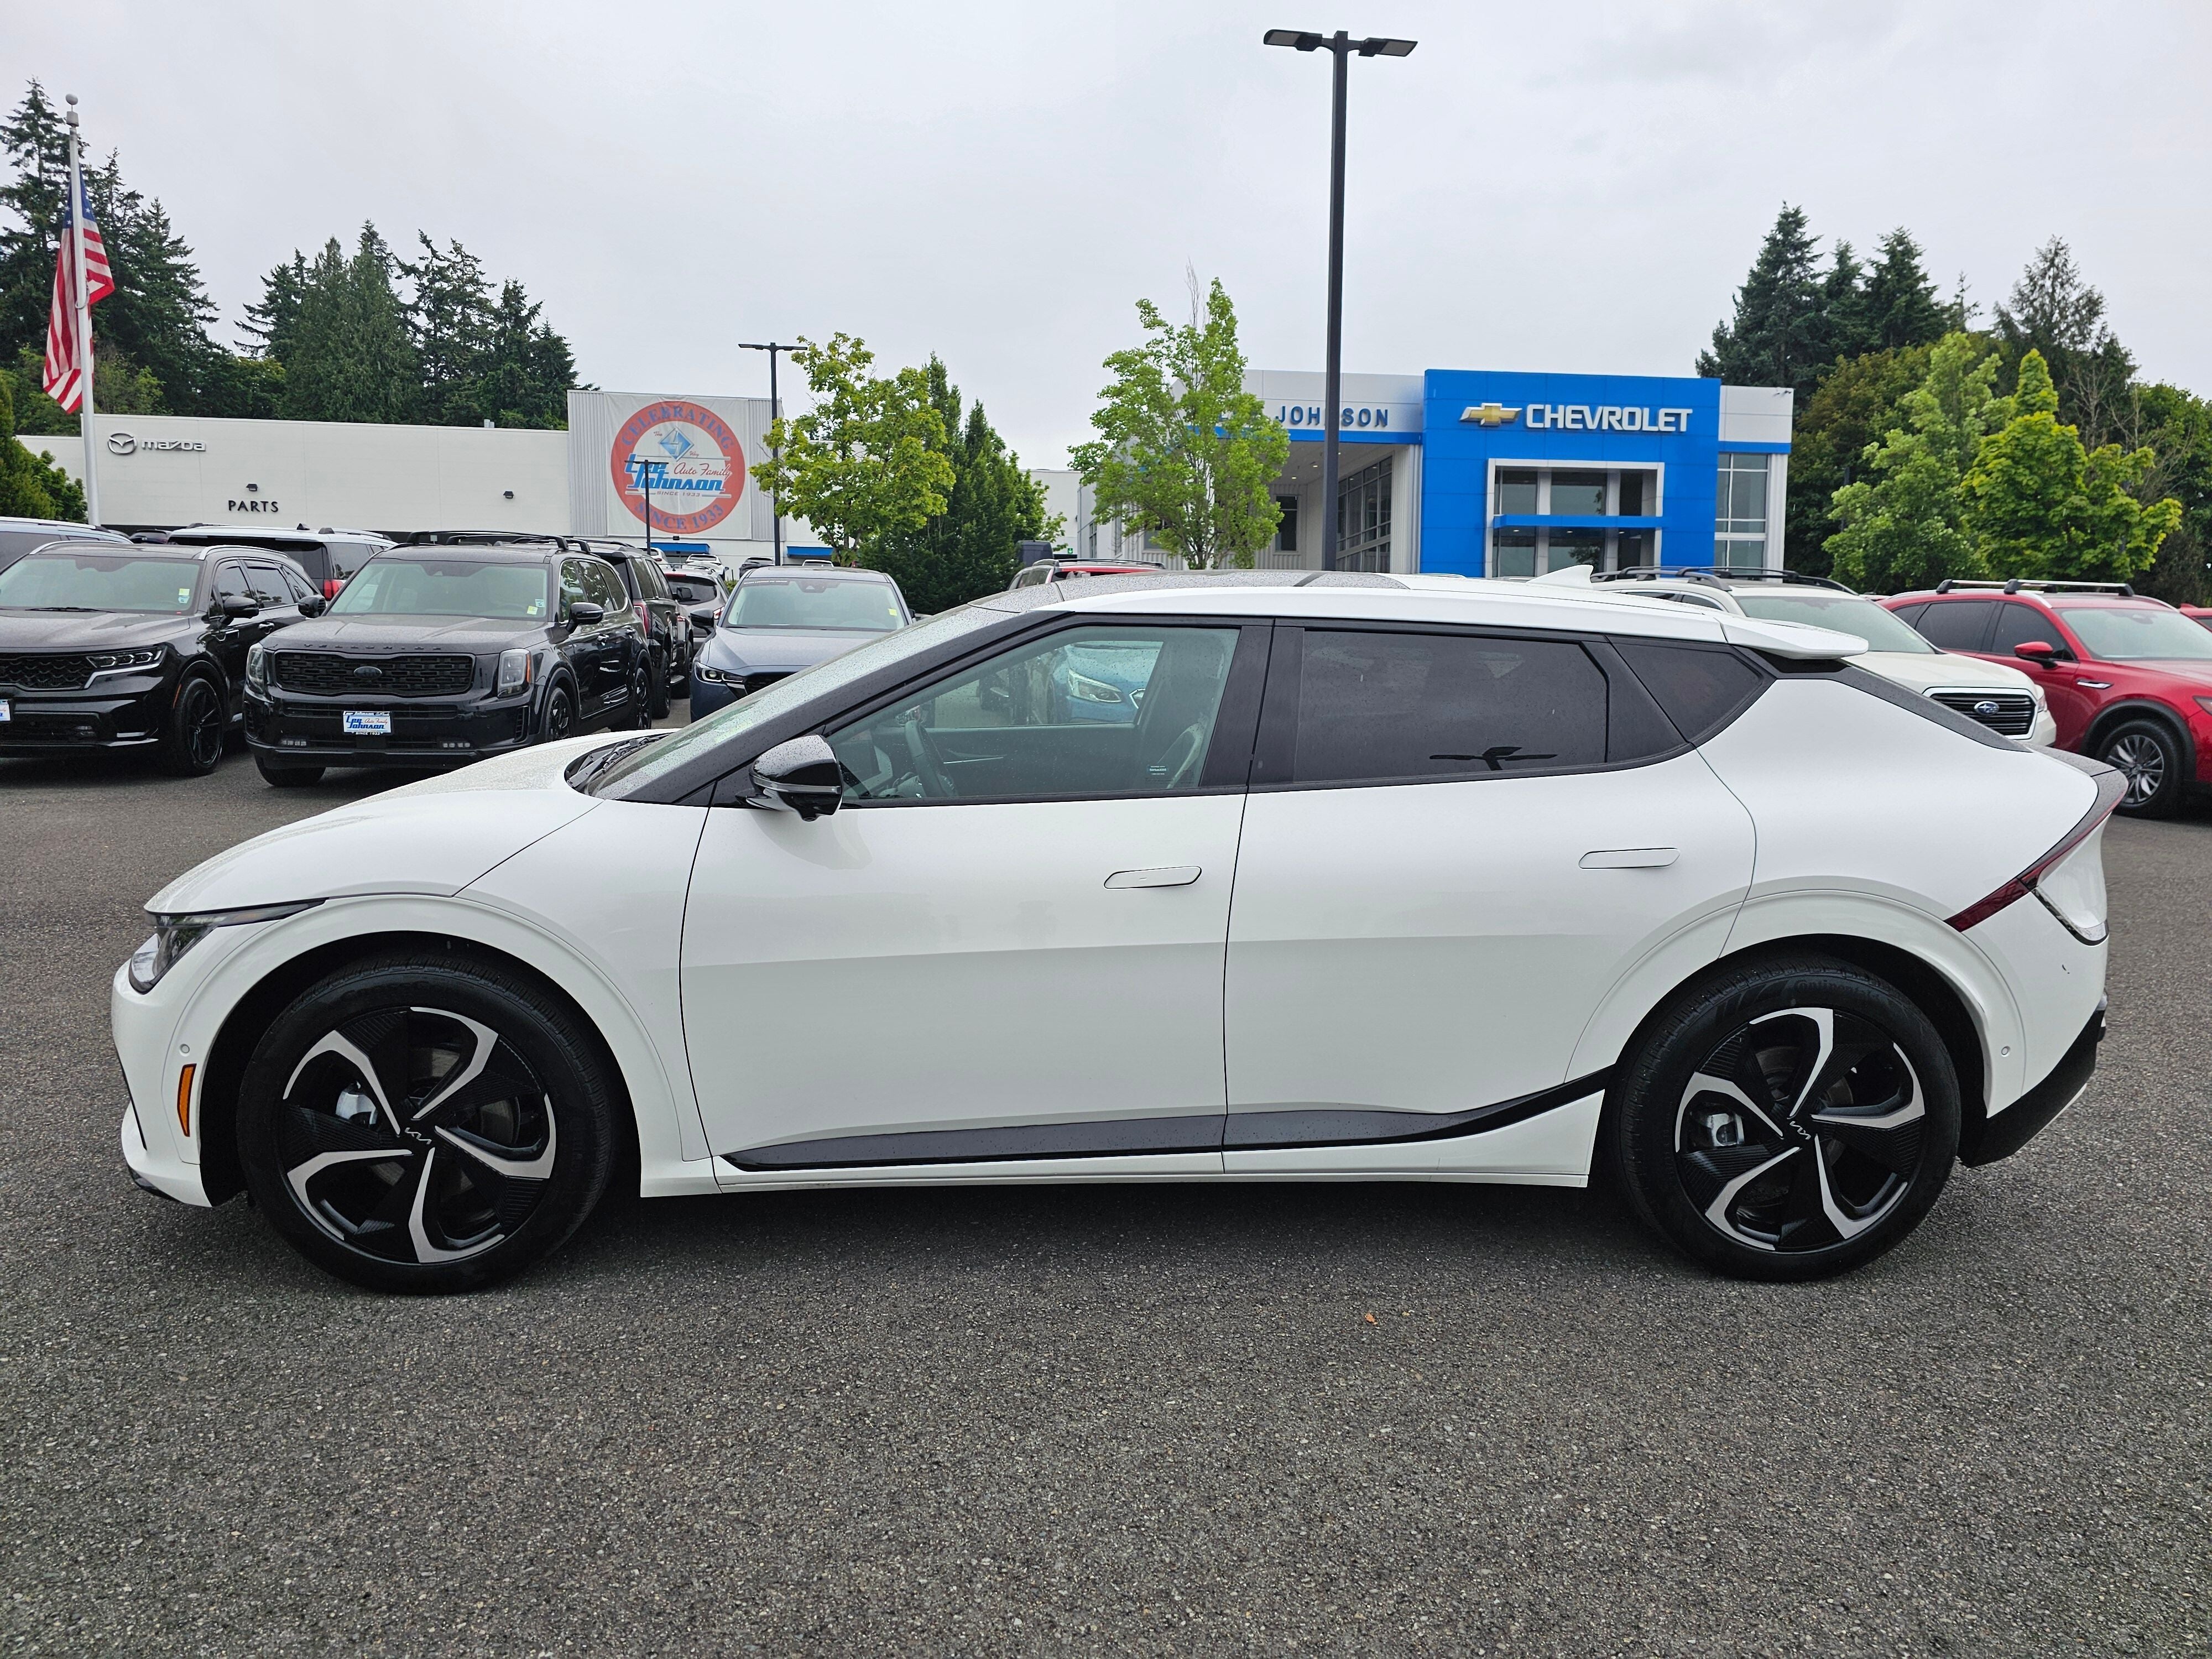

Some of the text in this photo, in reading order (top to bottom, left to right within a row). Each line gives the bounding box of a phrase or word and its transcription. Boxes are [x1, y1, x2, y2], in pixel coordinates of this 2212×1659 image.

[1275, 405, 1389, 427] JOHSON
[1526, 404, 1693, 432] CHEVROLET
[622, 405, 734, 450] CELEBRATING
[141, 438, 206, 452] mazda
[627, 464, 725, 491] Johnson
[674, 462, 698, 475] Auto
[699, 463, 732, 479] Family
[228, 500, 279, 512] PARTS
[692, 504, 724, 528] 1933
[347, 719, 385, 729] Johnson
